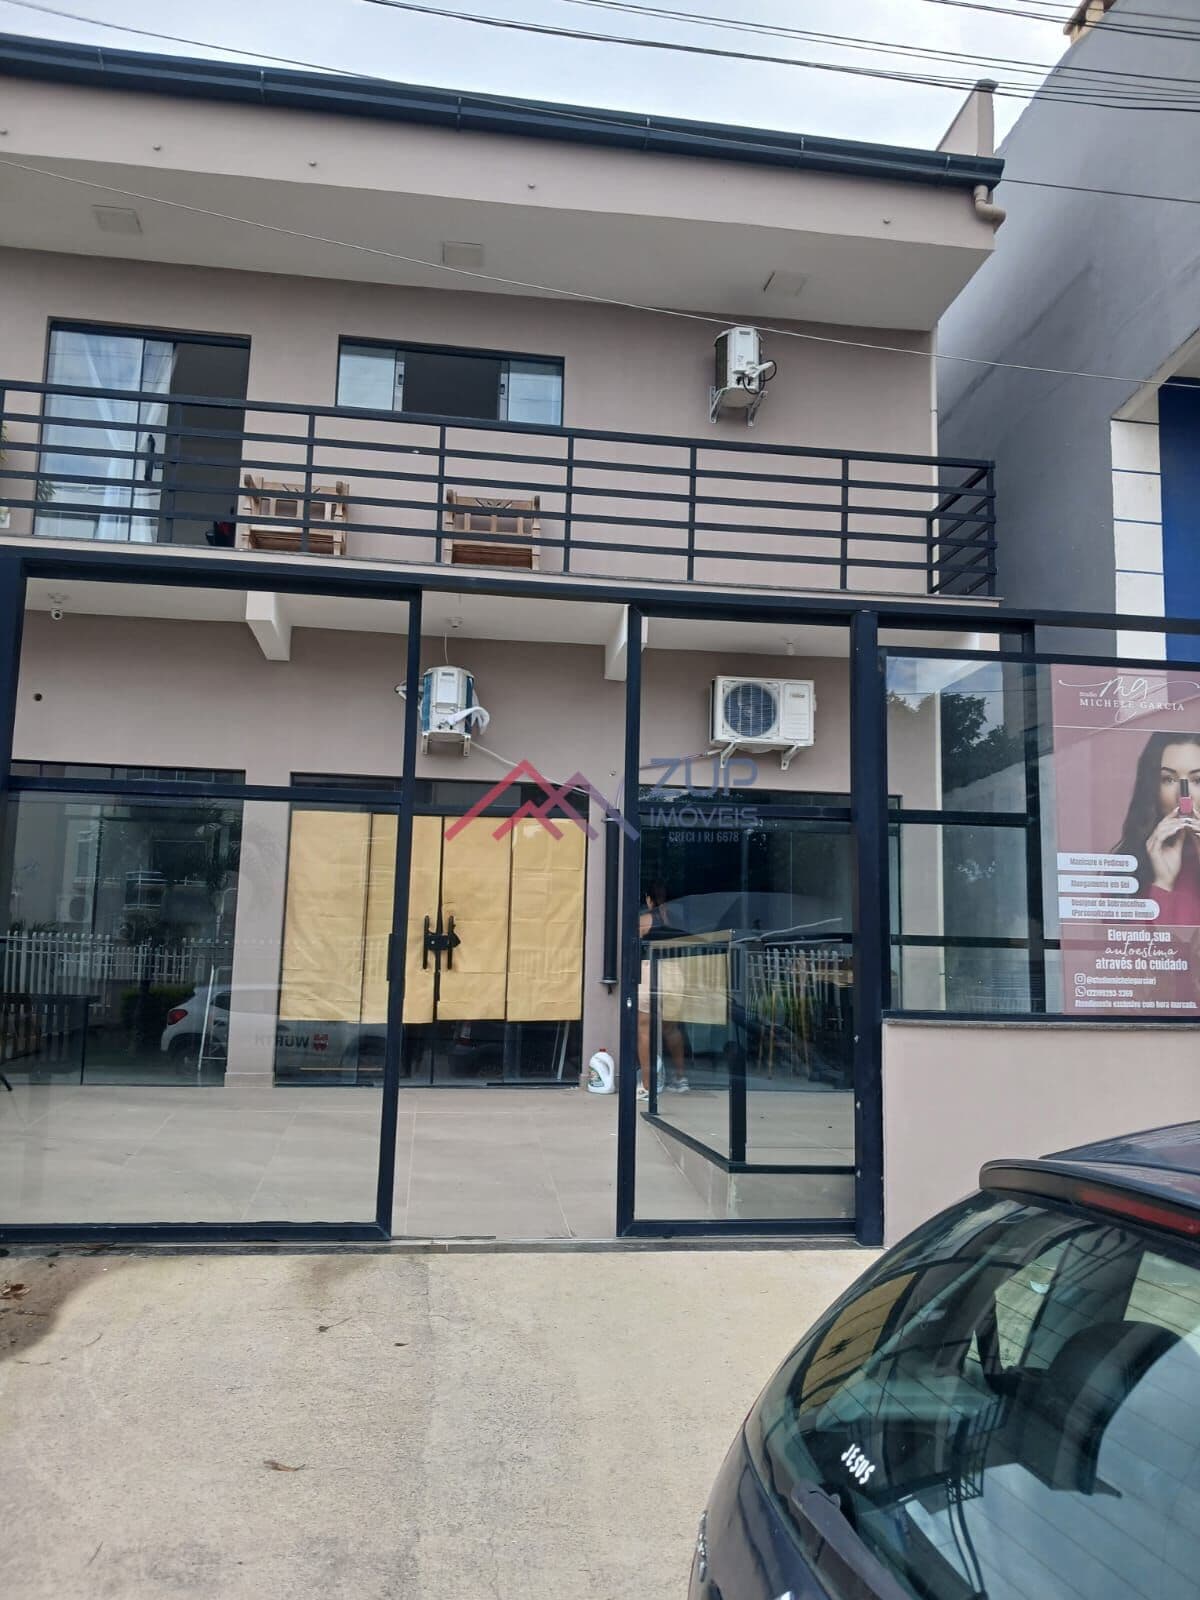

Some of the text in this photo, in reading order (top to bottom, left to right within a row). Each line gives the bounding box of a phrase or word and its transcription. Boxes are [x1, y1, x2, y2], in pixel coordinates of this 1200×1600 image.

[1079, 698, 1185, 711] MICHELE GARCIA
[1107, 928, 1171, 942] Elevando sua
[1104, 939, 1179, 957] autoestima
[1095, 957, 1188, 971] através do cuidado
[841, 1443, 876, 1485] JESUS
